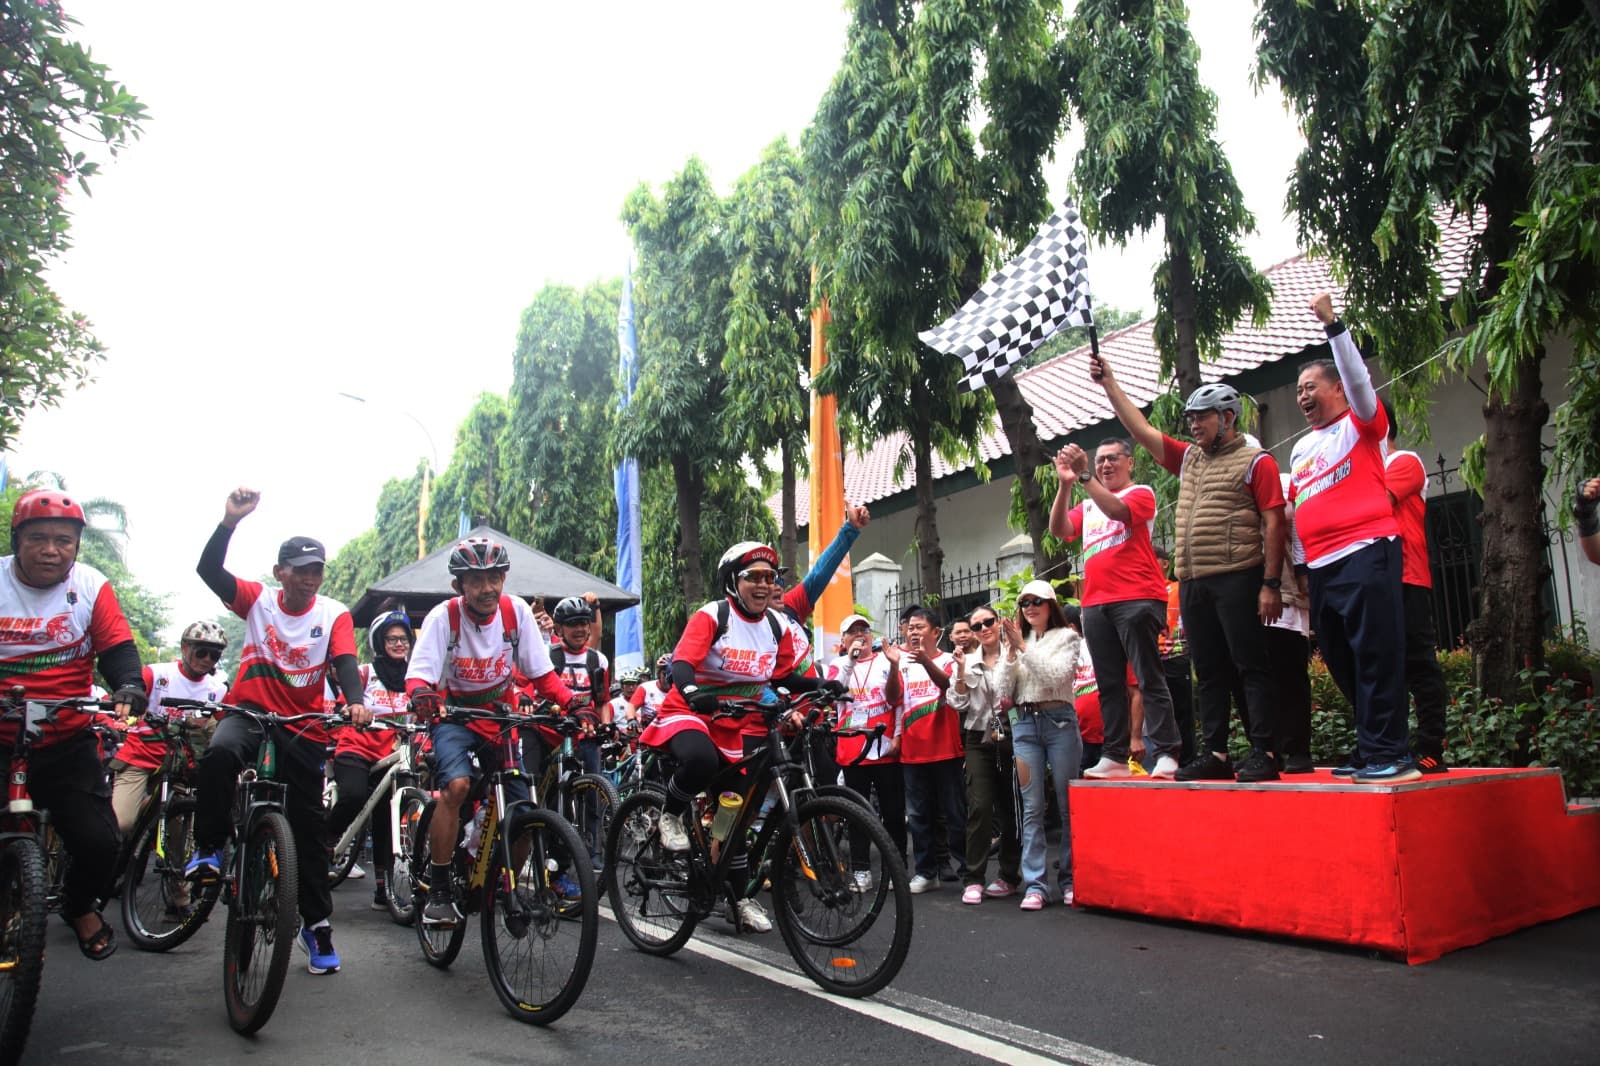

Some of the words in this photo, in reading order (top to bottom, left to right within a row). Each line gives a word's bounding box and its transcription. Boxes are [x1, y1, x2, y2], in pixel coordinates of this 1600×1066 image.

[13, 616, 44, 630] BIKE
[720, 647, 738, 661] FUN
[739, 648, 758, 662] BIKE
[724, 661, 751, 672] 2025
[459, 668, 485, 680] 2025
